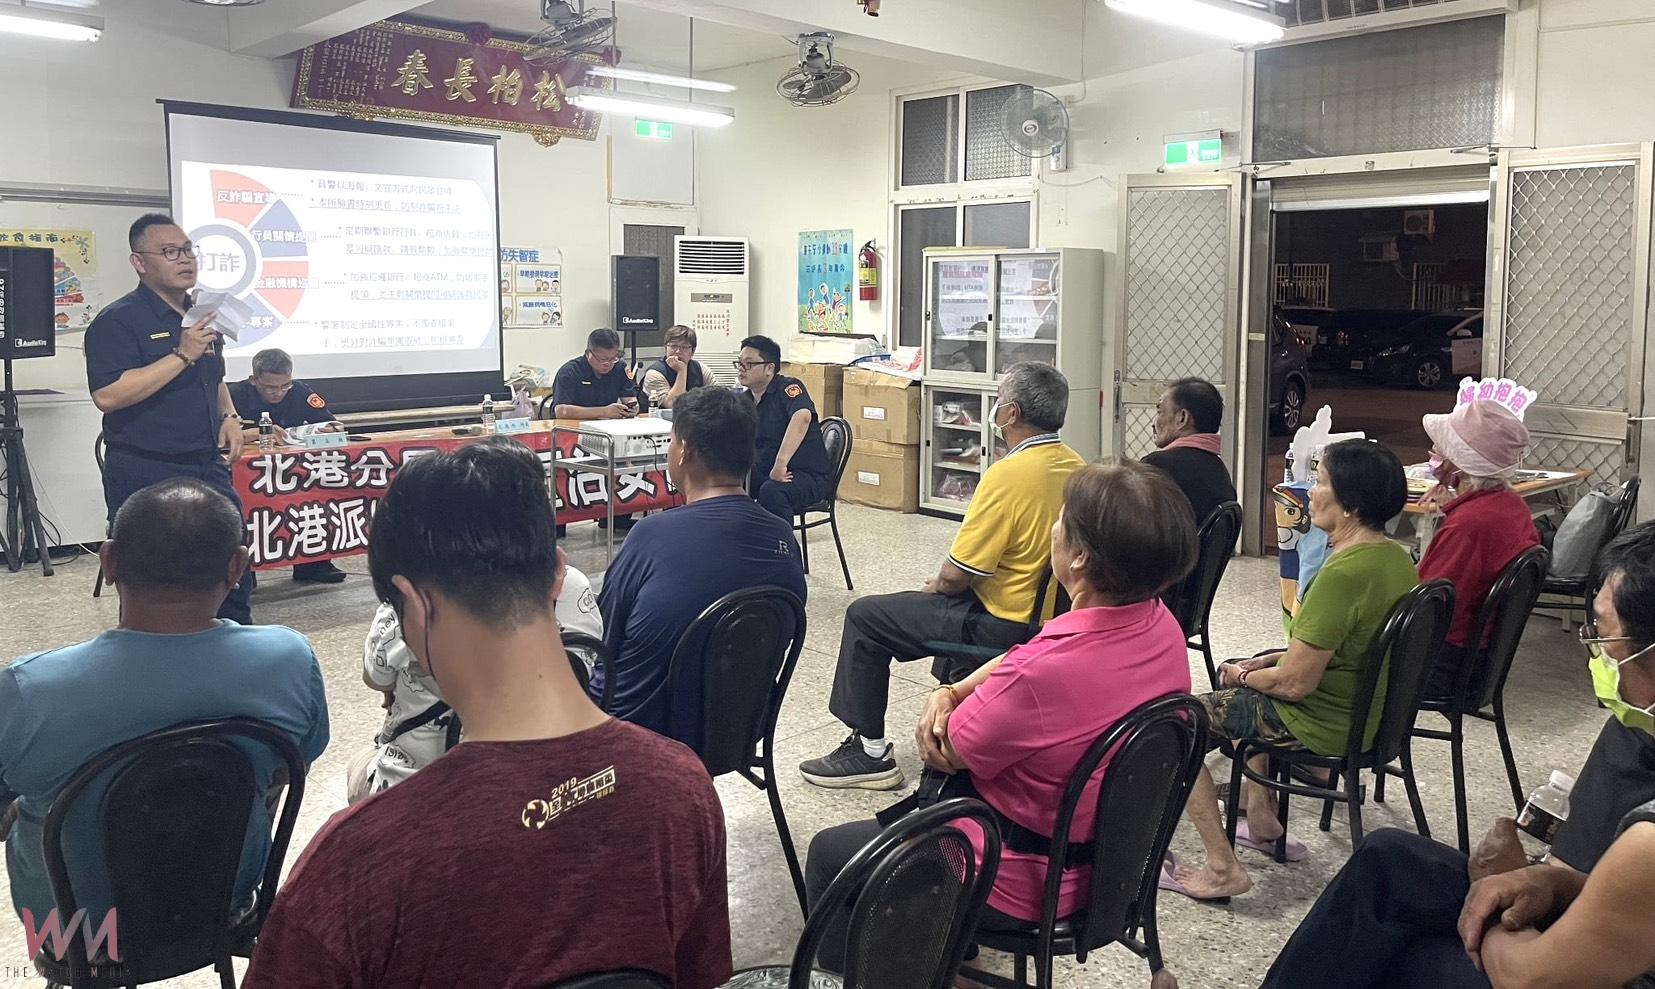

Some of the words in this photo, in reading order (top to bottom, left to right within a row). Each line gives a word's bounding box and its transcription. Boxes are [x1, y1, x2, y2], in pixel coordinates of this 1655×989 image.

[241, 315, 275, 329] 專案
[247, 498, 376, 563] 北港派
[551, 777, 577, 799] 2019
